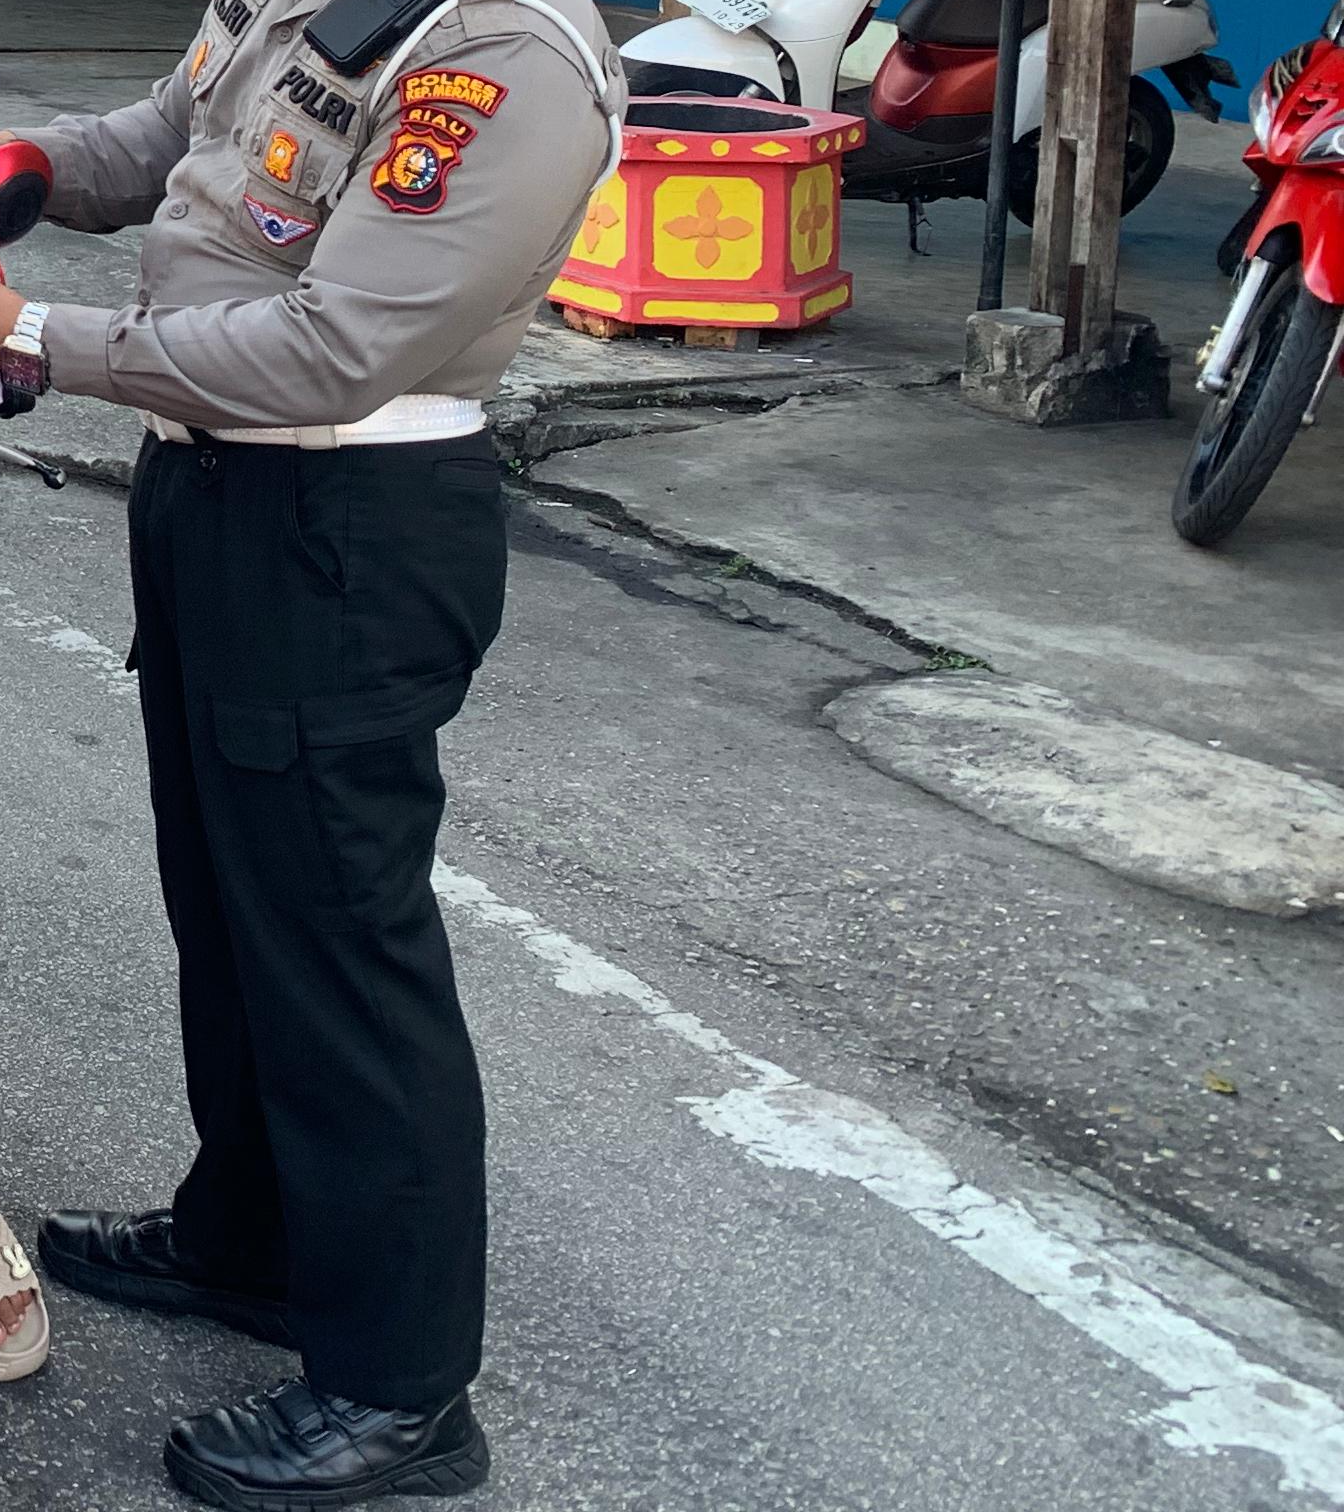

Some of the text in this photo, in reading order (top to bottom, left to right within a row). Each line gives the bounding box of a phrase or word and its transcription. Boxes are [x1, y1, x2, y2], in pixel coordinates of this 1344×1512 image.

[406, 72, 498, 99] POLRES
[273, 64, 357, 136] POLRI
[408, 108, 467, 136] RIAU
